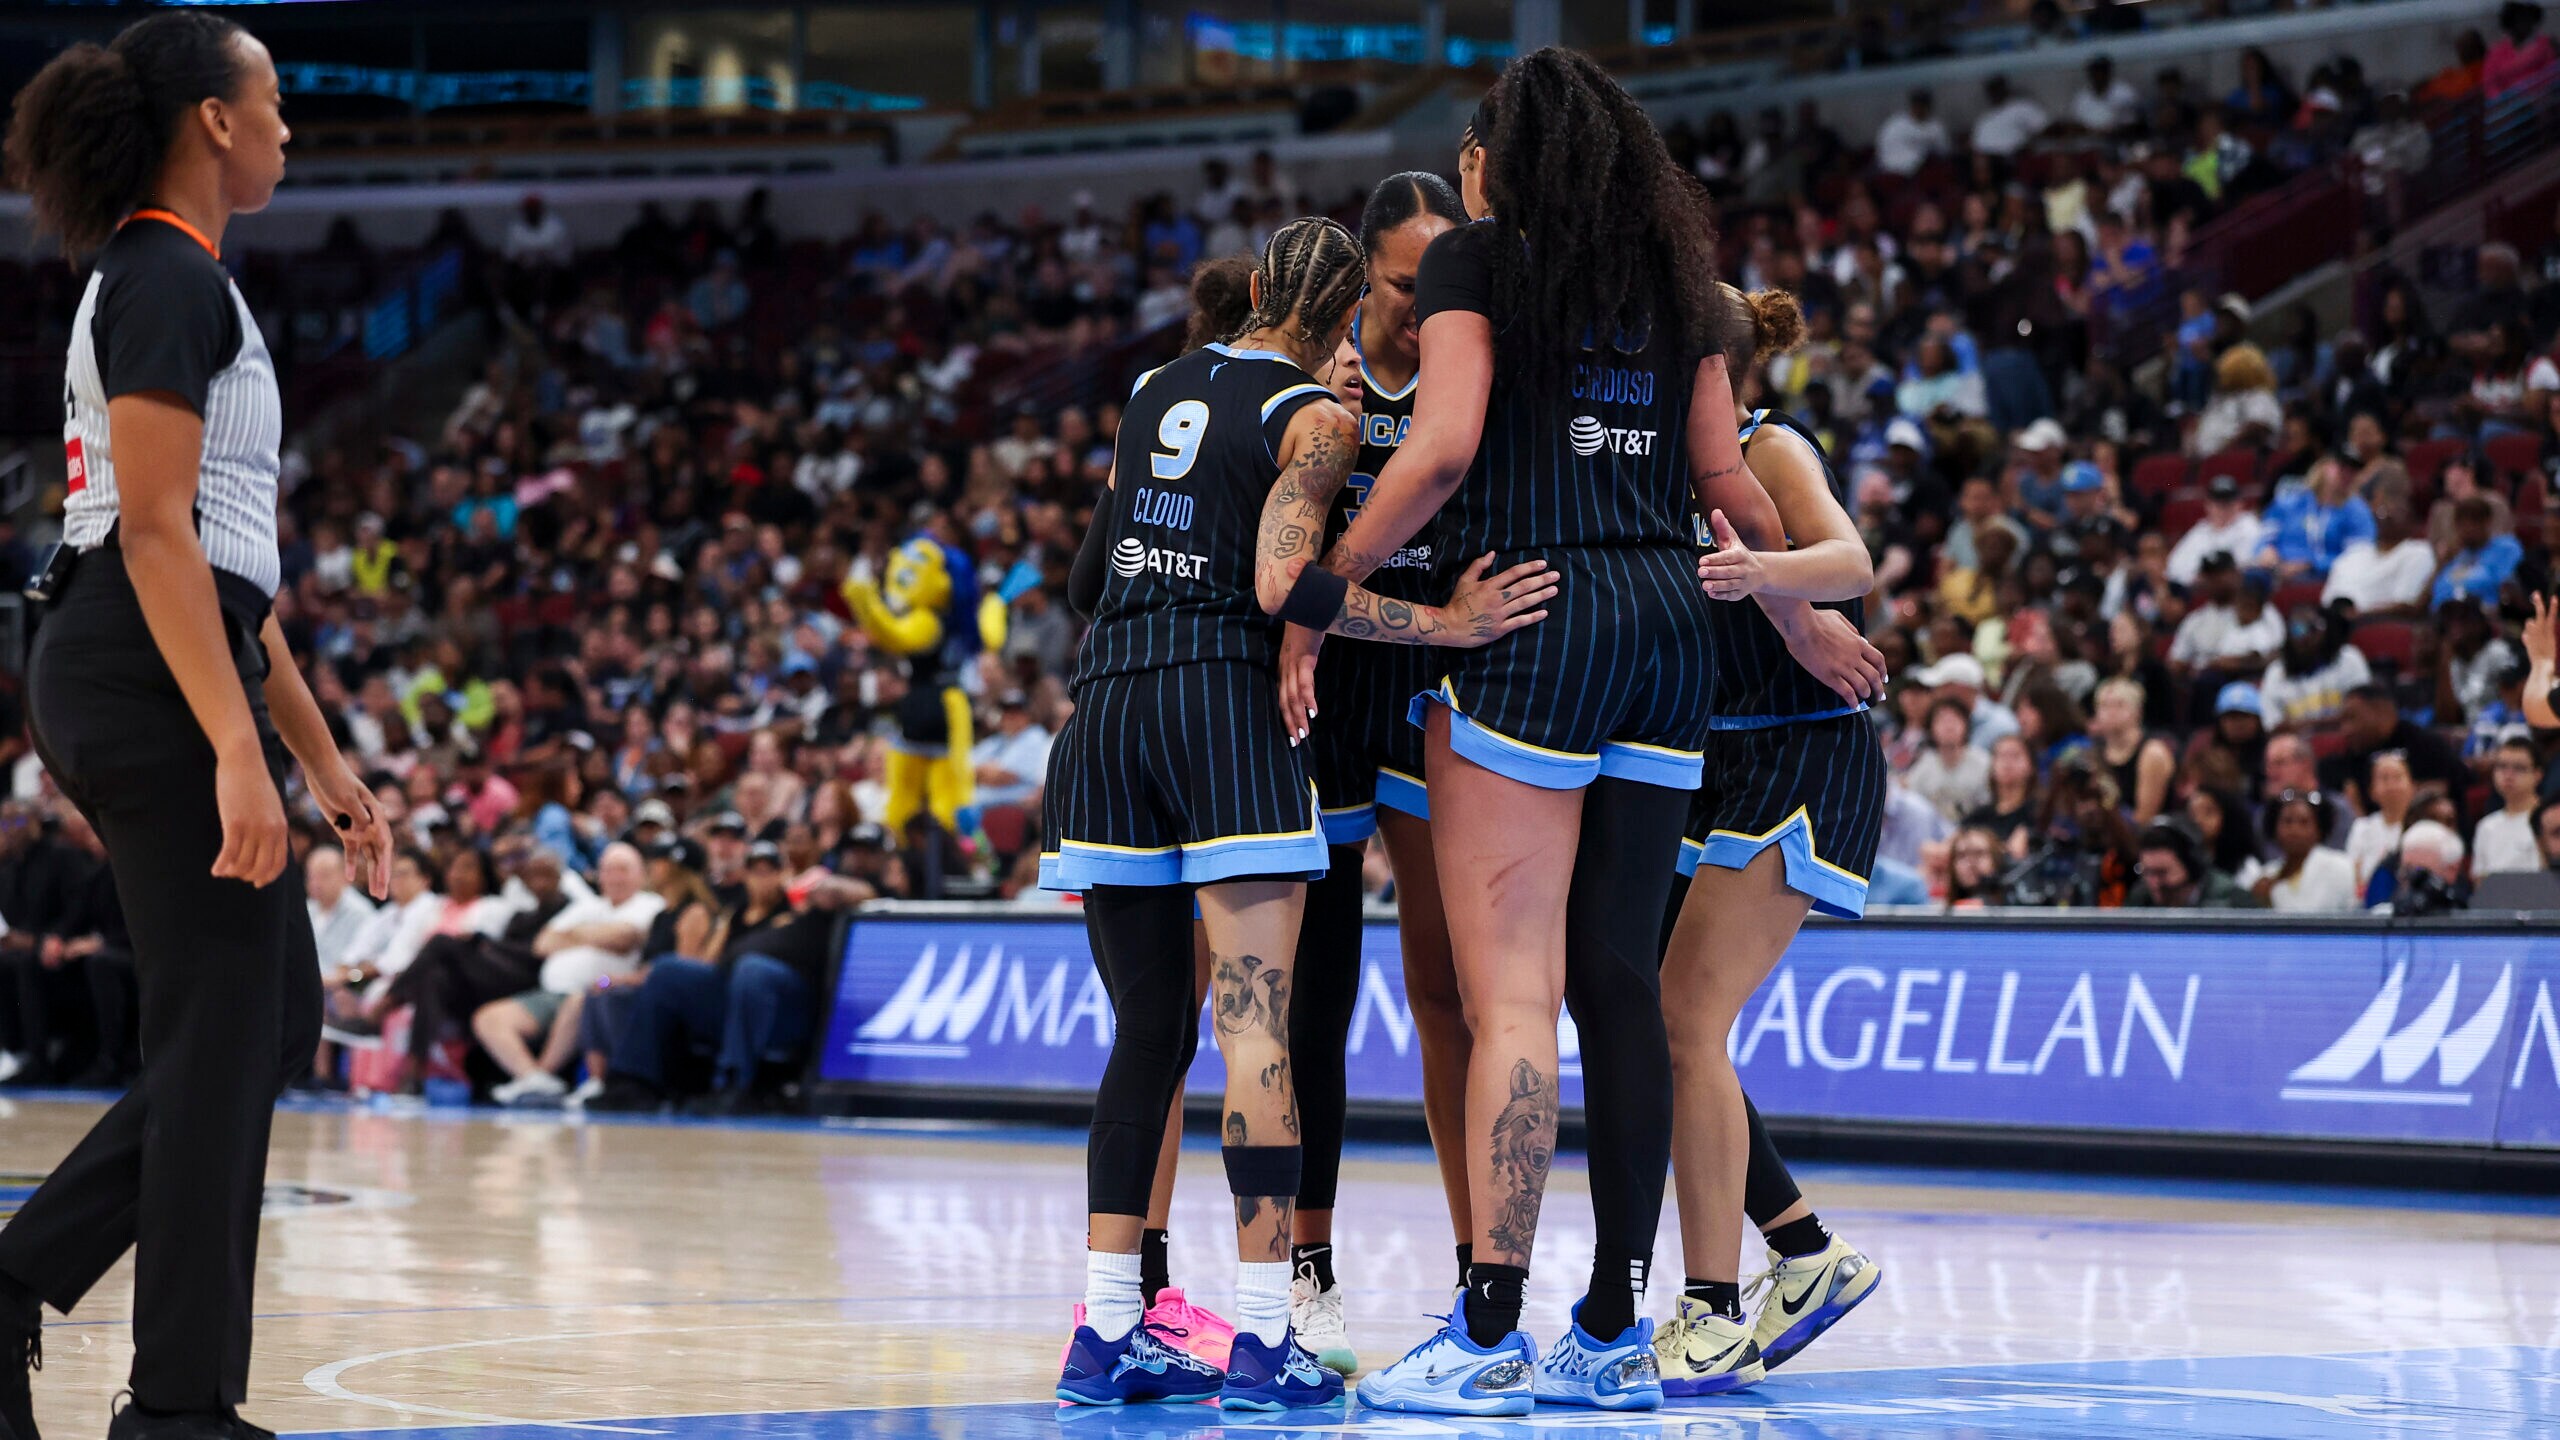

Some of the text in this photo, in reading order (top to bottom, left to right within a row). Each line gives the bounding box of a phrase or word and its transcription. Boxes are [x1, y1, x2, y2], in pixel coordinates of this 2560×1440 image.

[1572, 363, 1655, 406] CRDOSO
[1150, 400, 1210, 480] 9
[1133, 487, 1194, 531] CLOUD
[1274, 524, 1307, 559] 9
[1147, 547, 1209, 580] AT&T
[1727, 965, 2200, 1080] AGELLAN
